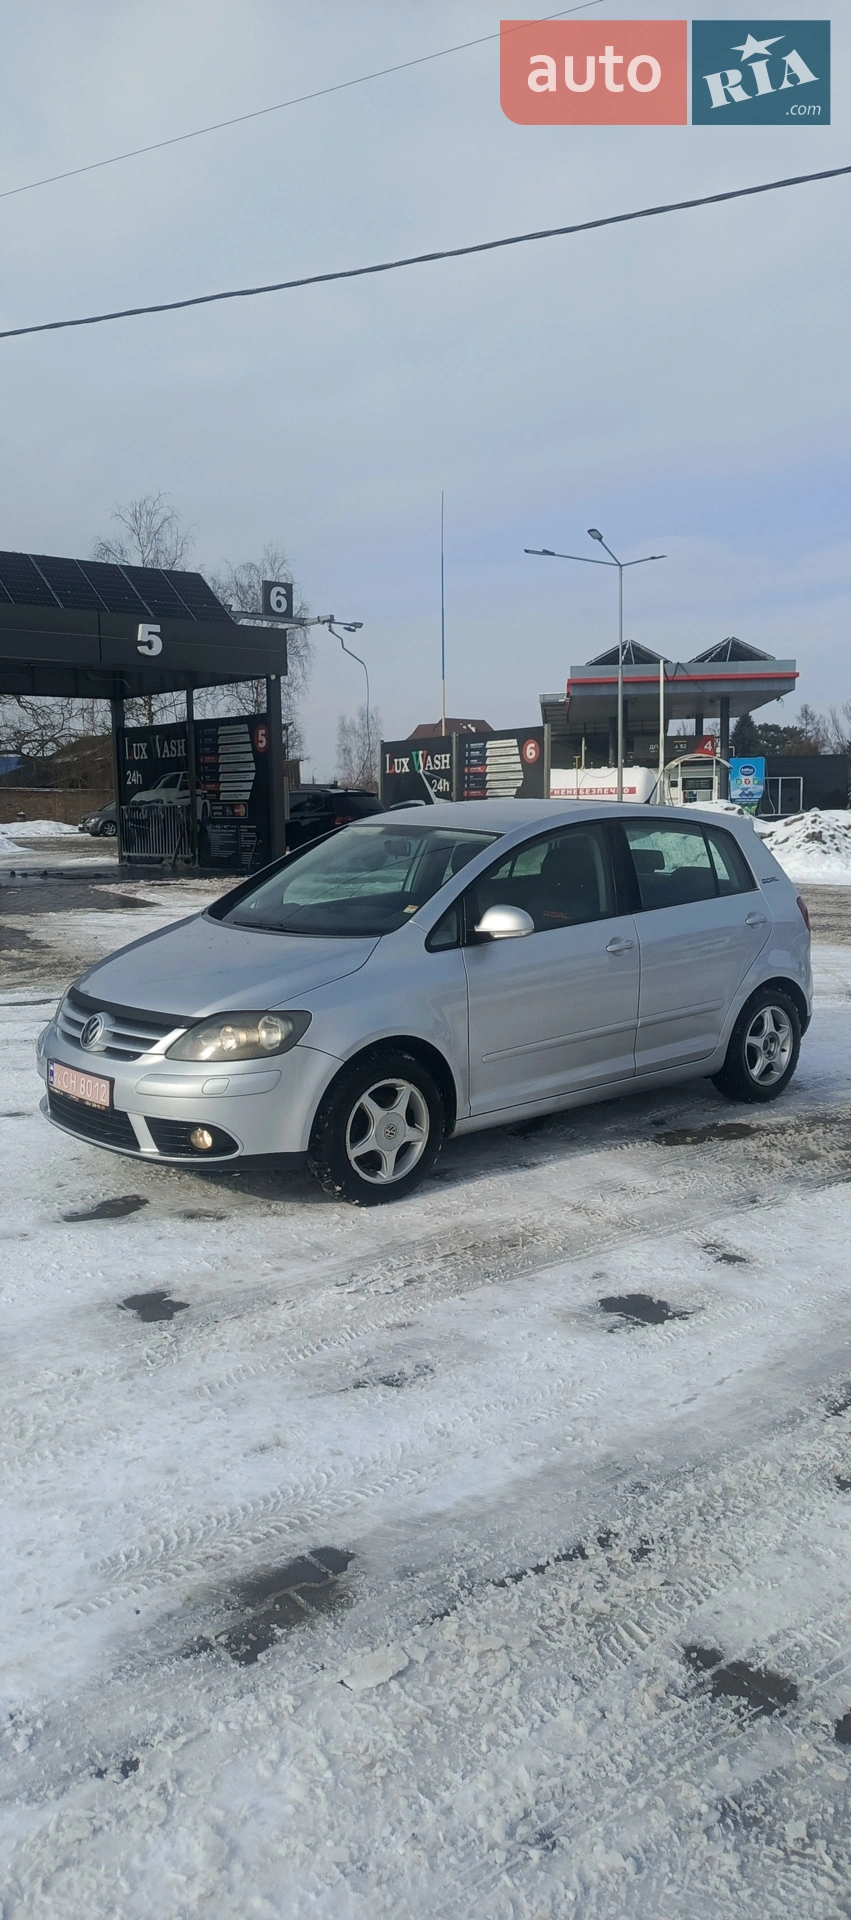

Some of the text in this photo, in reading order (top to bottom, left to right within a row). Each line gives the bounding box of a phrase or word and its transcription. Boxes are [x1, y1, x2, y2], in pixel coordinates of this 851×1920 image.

[269, 586, 288, 613] 6
[136, 623, 163, 657] 5
[257, 729, 267, 748] 5
[703, 740, 713, 751] 4
[525, 742, 536, 760] 6
[126, 770, 143, 785] 24h
[431, 778, 450, 793] 24h
[80, 1077, 107, 1103] 8012
